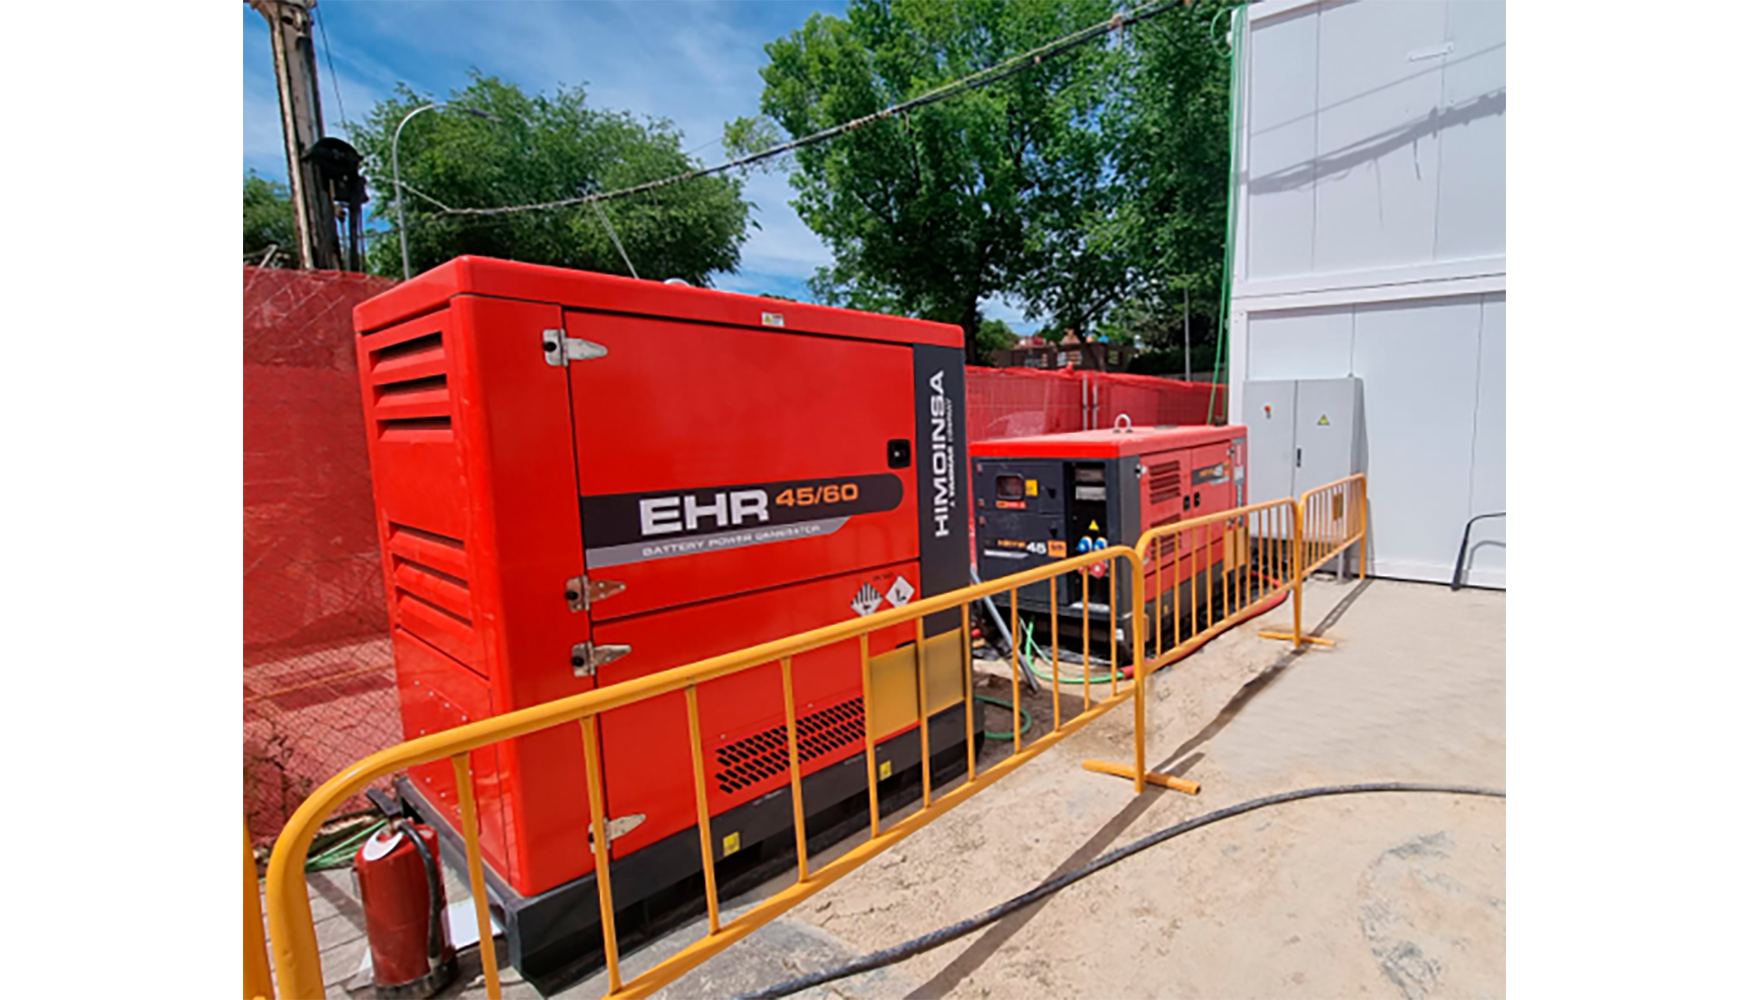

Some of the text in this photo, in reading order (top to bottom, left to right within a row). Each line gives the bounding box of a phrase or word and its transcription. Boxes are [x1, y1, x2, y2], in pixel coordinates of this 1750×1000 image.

[929, 370, 950, 538] HIMOINSA
[639, 482, 860, 536] EHR 45/60
[642, 523, 822, 557] BATTERY POWER GENERATOR
